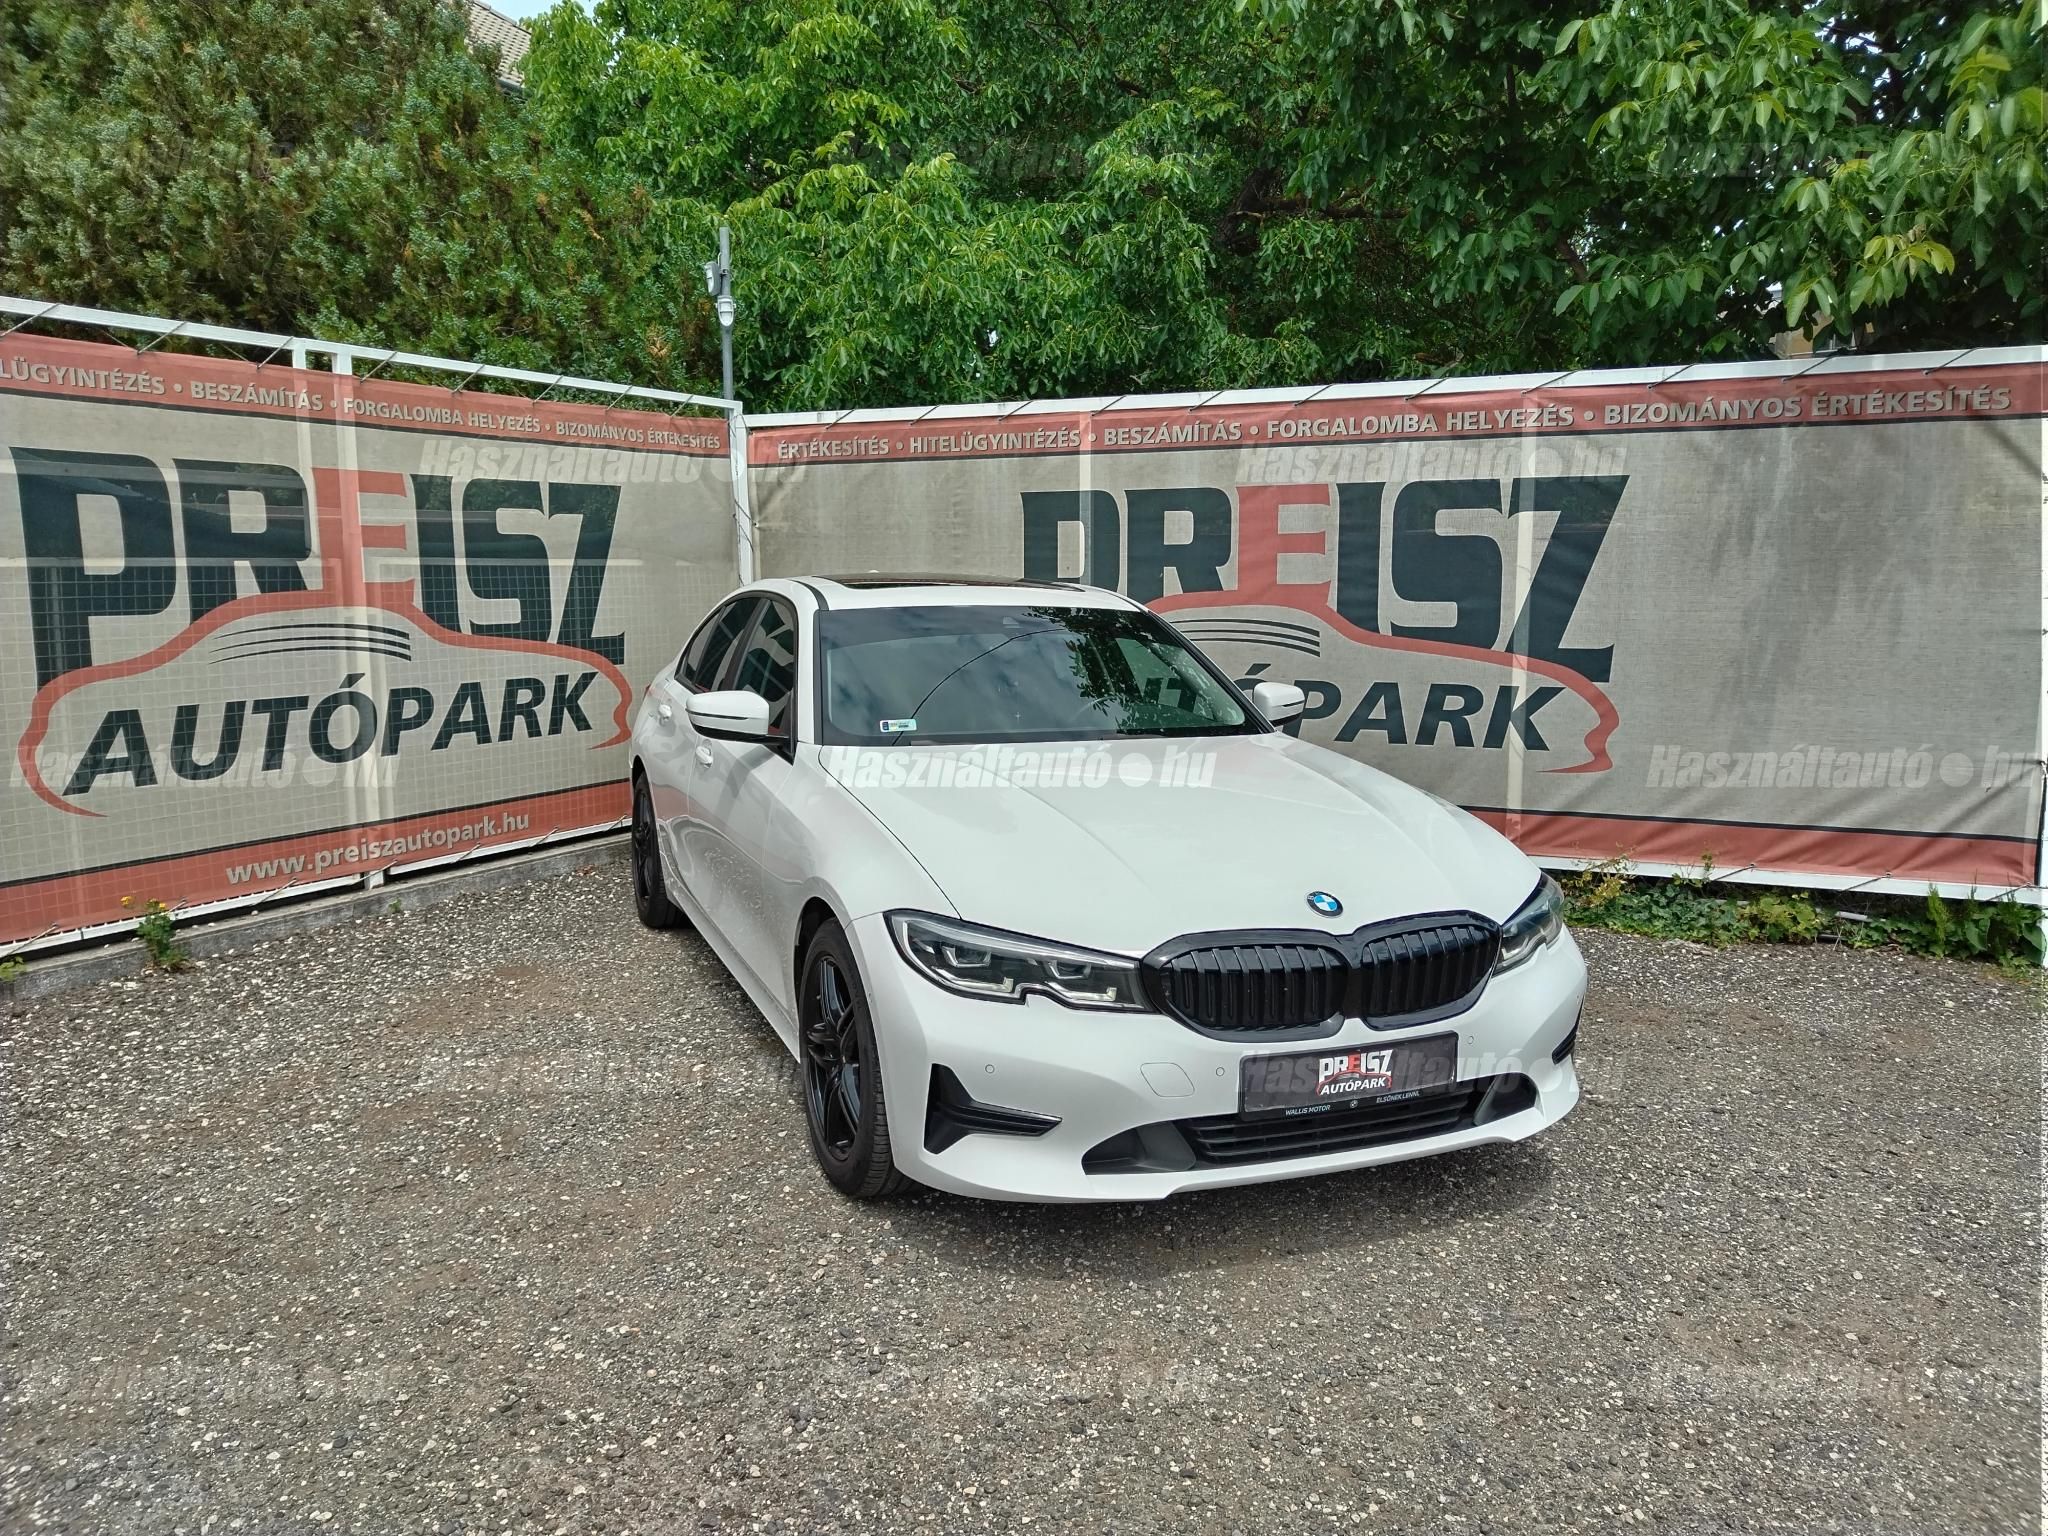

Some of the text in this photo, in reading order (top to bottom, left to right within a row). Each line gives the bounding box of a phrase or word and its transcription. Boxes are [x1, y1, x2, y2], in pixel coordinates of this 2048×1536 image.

[191, 379, 324, 411] BESZÁMÍTÁS
[343, 397, 464, 426] FORGALOMBA
[468, 411, 541, 433] HELYEZÉS
[556, 418, 645, 444] BIZOMÁNYOS
[778, 384, 2012, 460] ÉRTÉKESÍTÉS HITELÜGYINTÉZÉS BESZÁMÍTÁS FORGALOMBA HELYEZÉS BIZOMÁNYOS ÉRTÉKESÍTÉS
[9, 447, 626, 690] PREISZ
[62, 672, 600, 796] AUTÓPARK
[225, 811, 530, 885] www.preiszautopark.hu
[1318, 1049, 1394, 1084] PREISZ
[1320, 1077, 1387, 1096] AUTÓPARK
[1308, 1104, 1331, 1113] MOTOR
